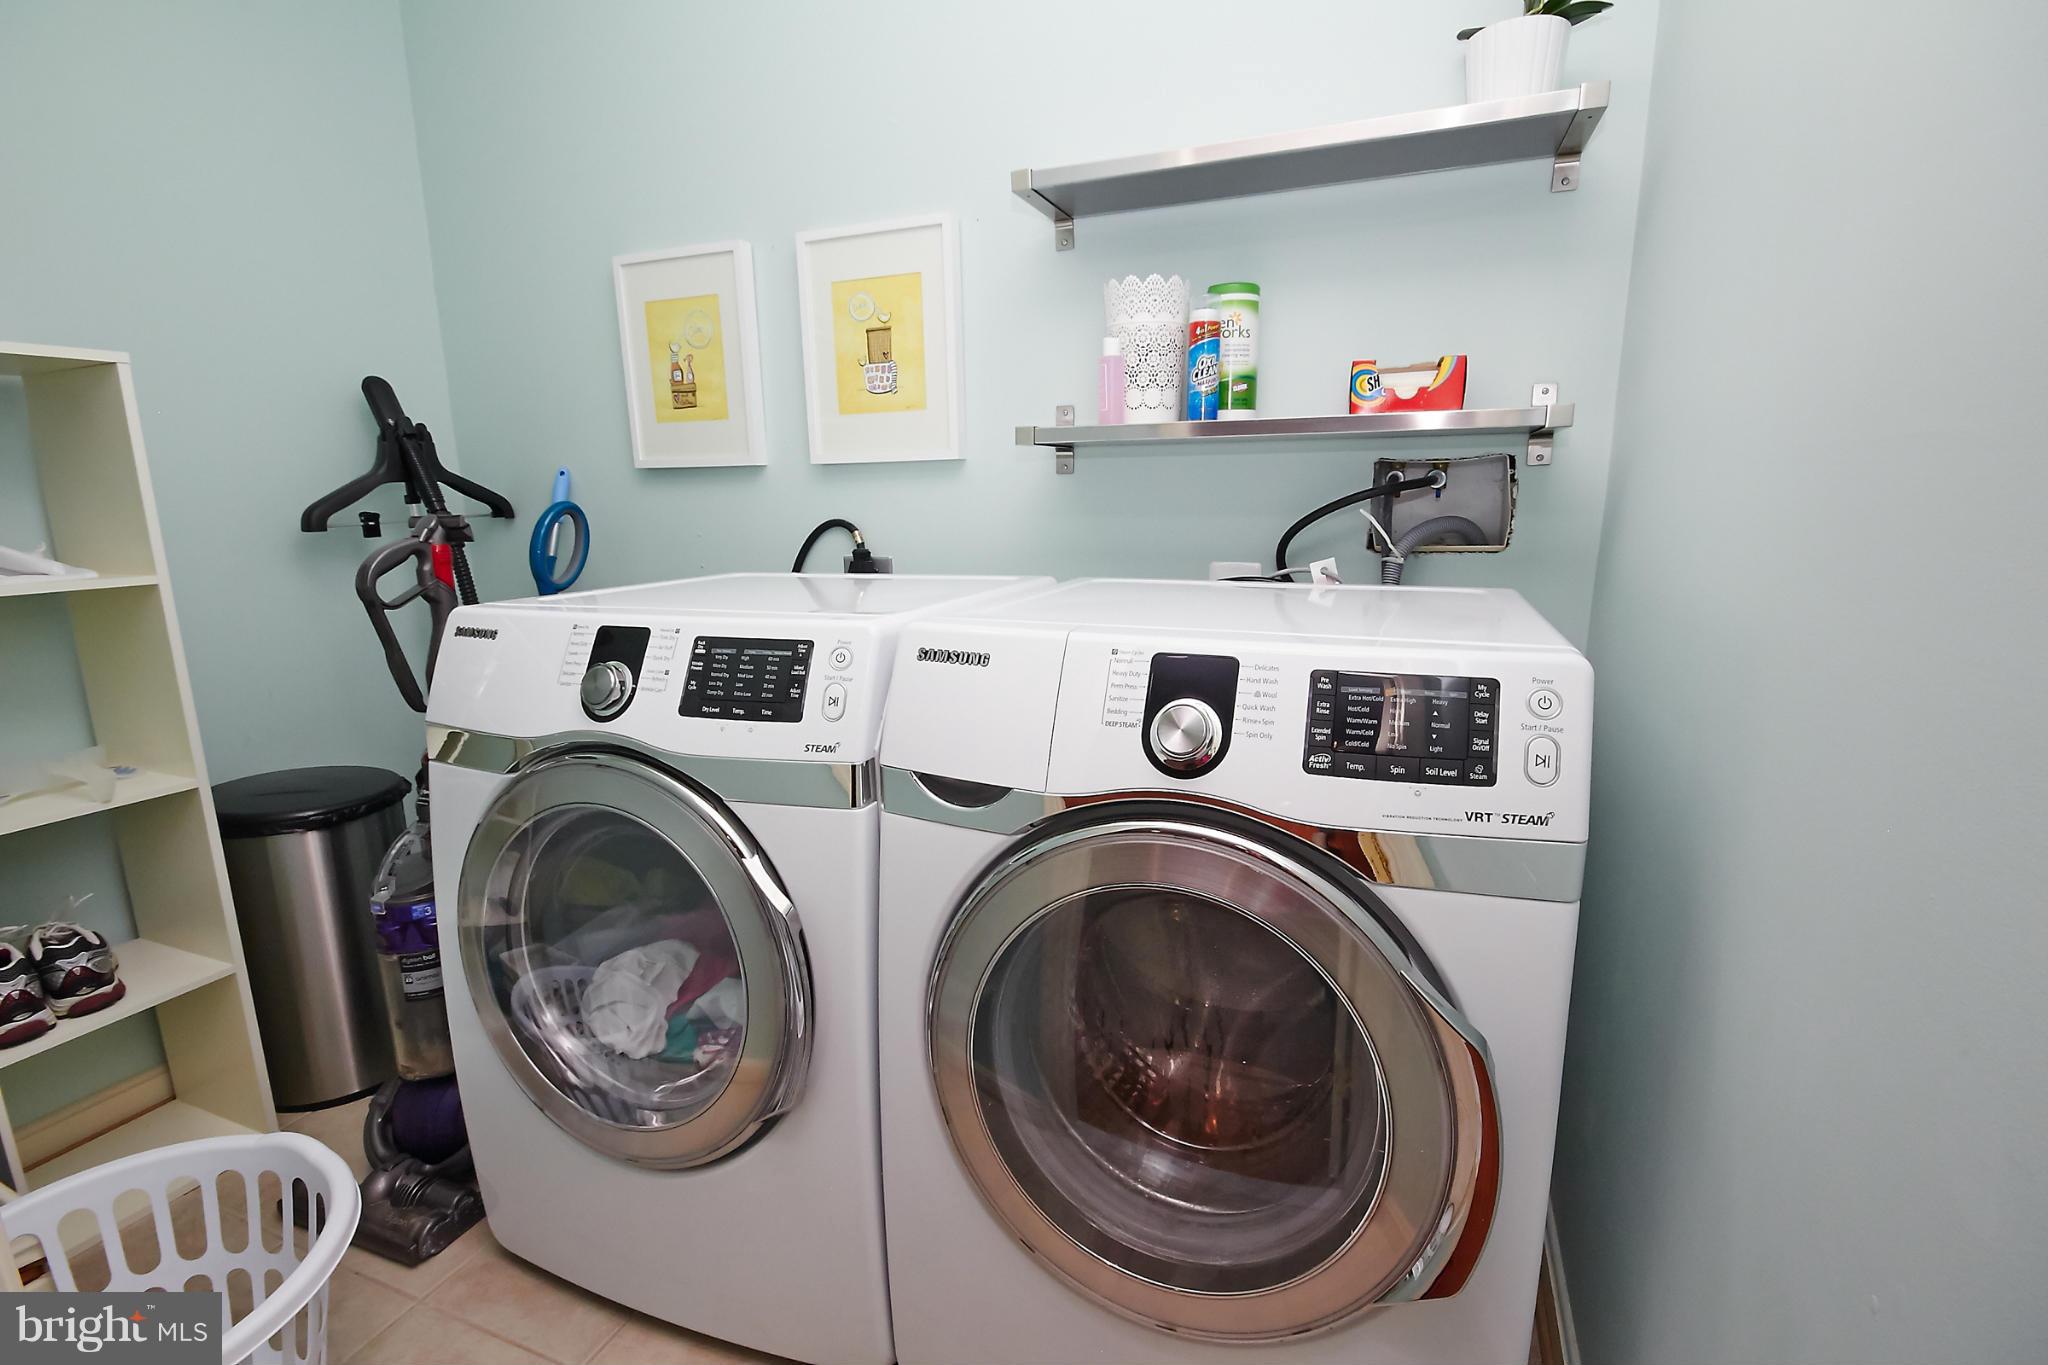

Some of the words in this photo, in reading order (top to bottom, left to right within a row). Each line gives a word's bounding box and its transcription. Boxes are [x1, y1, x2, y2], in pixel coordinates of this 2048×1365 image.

[1220, 324, 1250, 338] orks
[454, 626, 498, 640] SAMSUNG
[917, 647, 990, 667] SAMSUNG
[1107, 708, 1128, 716] Bedding
[1521, 723, 1537, 731] Start
[1543, 725, 1564, 734] Pause
[804, 744, 837, 753] STEAM
[1346, 762, 1365, 772] Temp.
[1390, 765, 1406, 775] Spin
[1440, 769, 1458, 777] Level
[1465, 811, 1493, 823] VRT
[1501, 813, 1550, 826] STEAM
